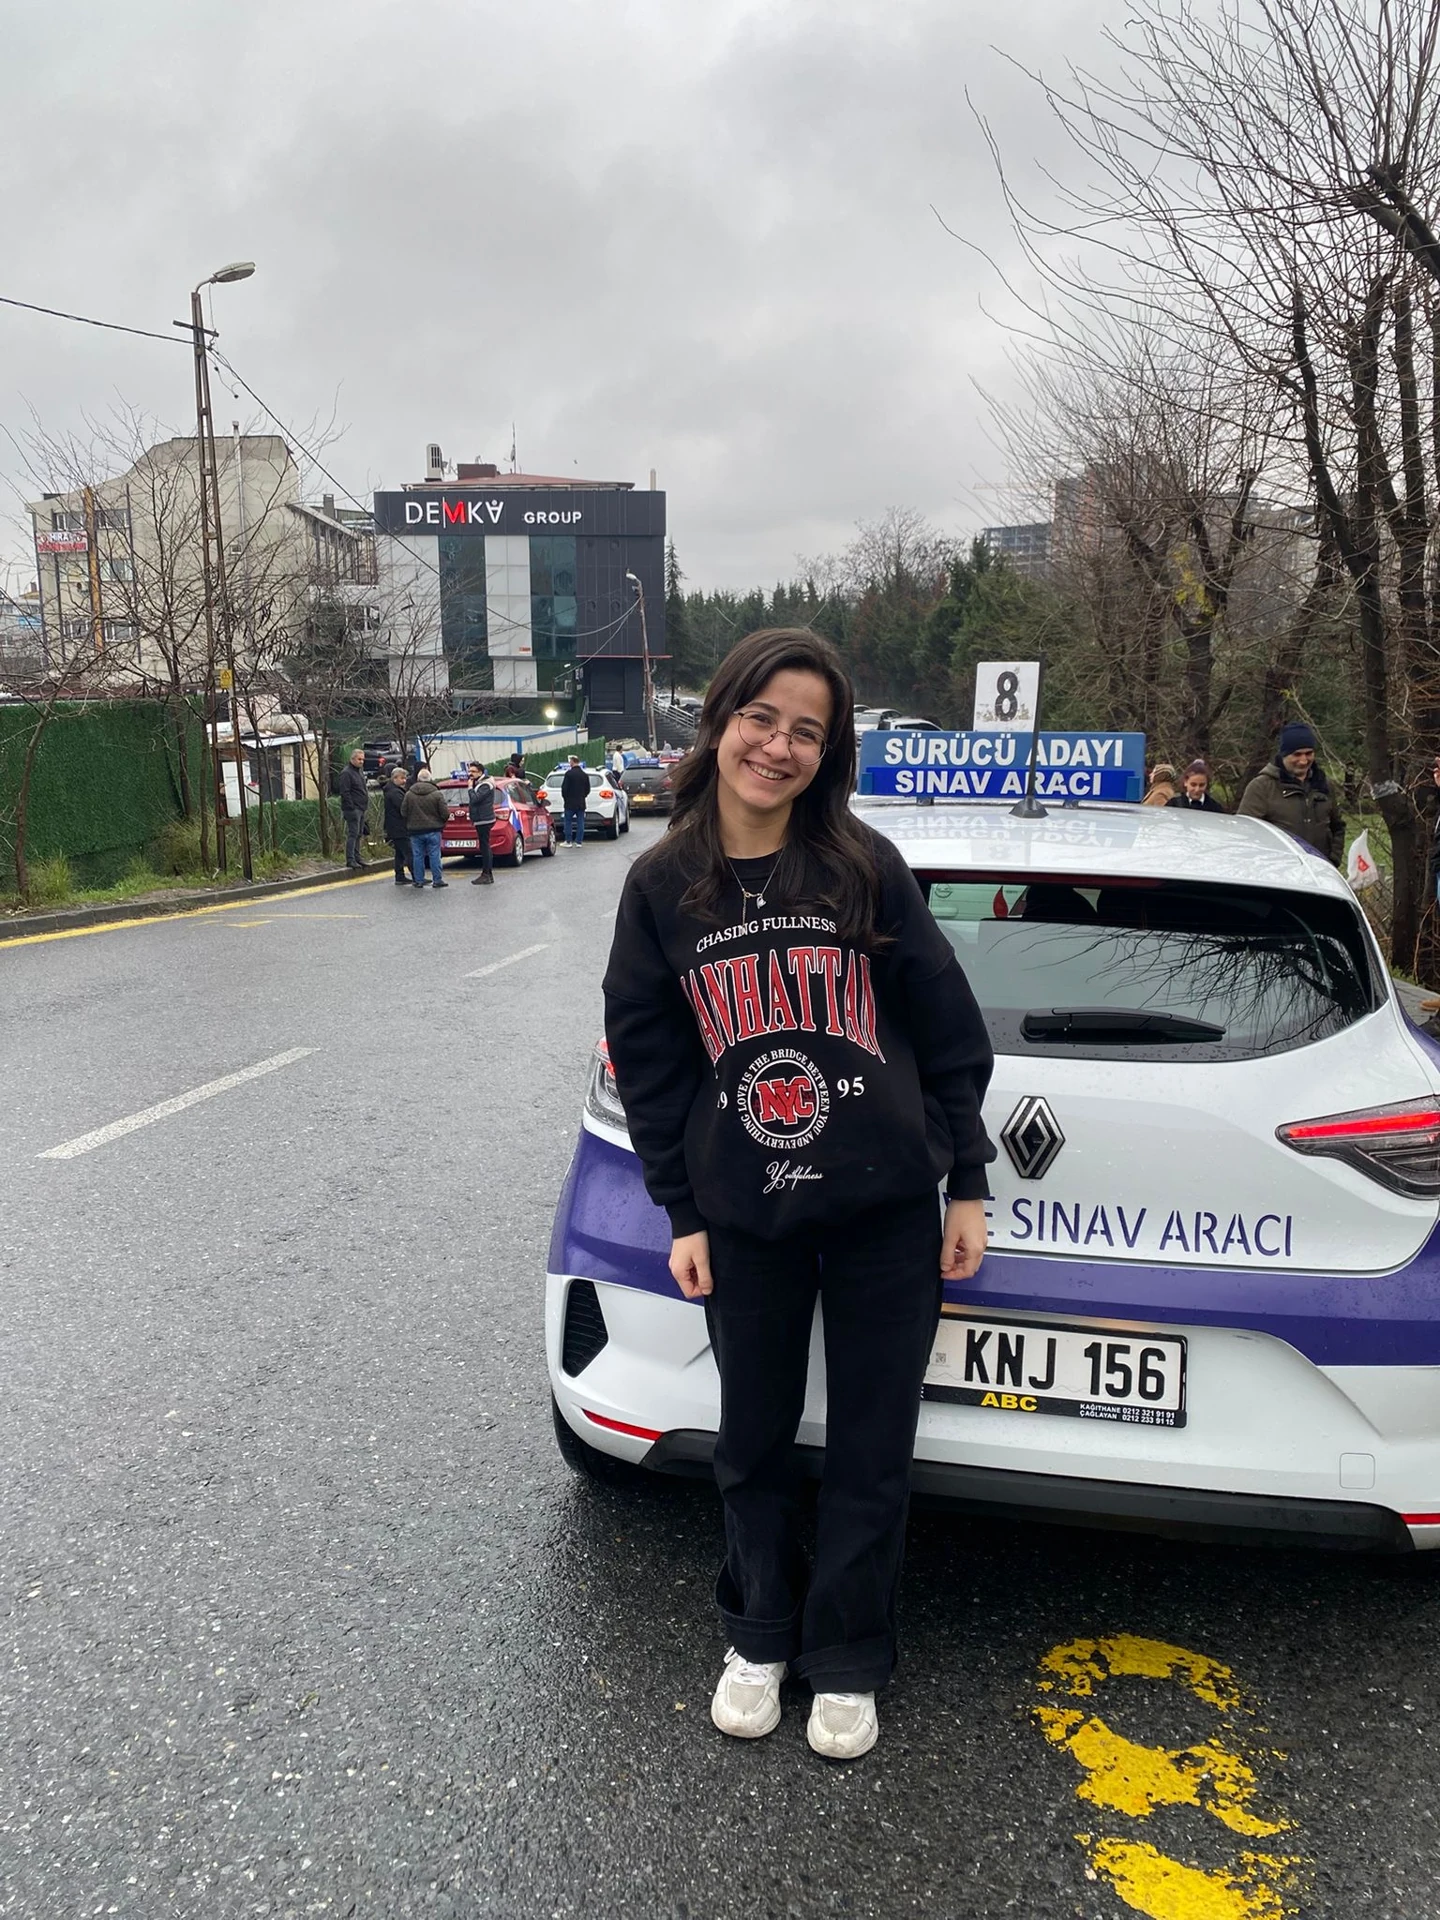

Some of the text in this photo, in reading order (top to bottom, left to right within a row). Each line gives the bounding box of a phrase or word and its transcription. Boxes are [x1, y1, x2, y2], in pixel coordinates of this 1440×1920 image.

[523, 511, 582, 524] GROUP
[994, 670, 1019, 722] 8
[884, 732, 1124, 767] SÜRÜCÜ ADAYI
[895, 770, 1102, 796] SINAV ARACI
[696, 916, 838, 953] CHASING FULLNESS
[748, 1054, 770, 1073] THE
[770, 1049, 807, 1065] BRIDGE
[742, 1072, 754, 1083] IS
[807, 1061, 830, 1113] BETWEEN
[837, 1076, 865, 1098] 95
[737, 1083, 748, 1112] LOVE
[755, 1075, 815, 1125] NYC
[815, 1114, 828, 1136] YOU
[763, 1160, 824, 1194] Youthfulness
[1009, 1197, 1147, 1249] SINAV
[1159, 1209, 1292, 1257] ARACI
[964, 1328, 1166, 1401] KNJ 156
[980, 1391, 1038, 1412] ABC
[1080, 1403, 1121, 1414] KAĞITHANE
[1122, 1407, 1140, 1415] 0212
[1141, 1409, 1154, 1417] 321
[1166, 1411, 1175, 1419] 91
[1080, 1410, 1117, 1419] ÇAĞLAYAN
[1122, 1414, 1139, 1422] 0212
[1141, 1416, 1154, 1424] 233
